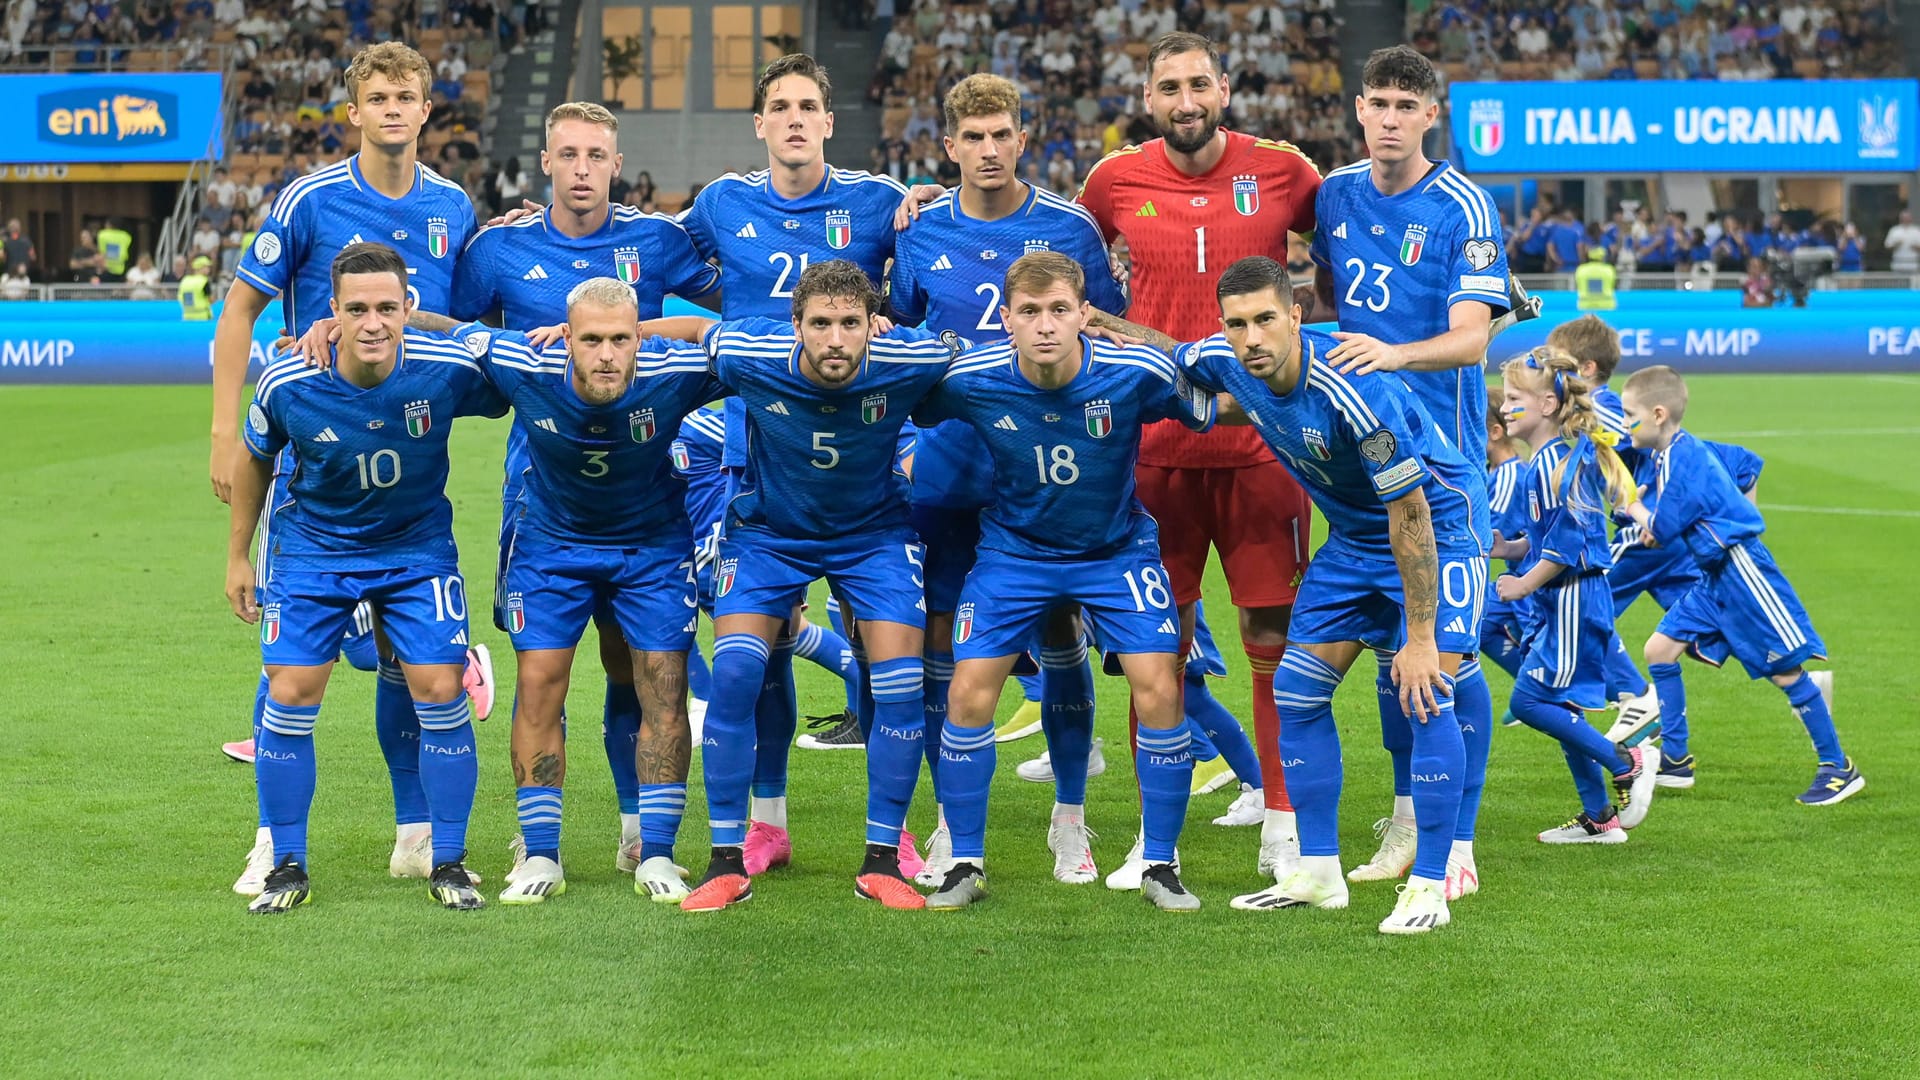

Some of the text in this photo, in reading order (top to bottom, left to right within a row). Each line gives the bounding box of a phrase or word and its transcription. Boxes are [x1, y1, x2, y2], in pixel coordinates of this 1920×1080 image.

[48, 99, 109, 136] eni
[1525, 107, 1841, 144] ITALIA - UCRAINA
[1235, 184, 1256, 192] ITALIA
[430, 225, 447, 234] ITALIA
[828, 218, 849, 226] ITALIA
[1406, 231, 1424, 241] ITALIA
[1195, 226, 1206, 272] 1
[616, 254, 637, 262] ITALIA
[1344, 257, 1394, 312] 23
[1685, 329, 1760, 356] МИР
[1, 339, 75, 367] МИР
[864, 399, 884, 407] ITALIA
[407, 408, 428, 418] ITALIA
[632, 415, 652, 425] ITALIA
[1088, 408, 1109, 416] ITALIA
[810, 432, 840, 469] 5
[356, 449, 402, 490] 10
[580, 451, 609, 478] 3
[1033, 444, 1080, 485] 18
[904, 544, 927, 589] 5
[679, 561, 698, 608] 3
[1123, 566, 1170, 612] 18
[430, 575, 466, 622] 10
[1052, 700, 1094, 712] ITALIA
[881, 725, 924, 741] ITALIA
[258, 747, 297, 760] ITALIA
[425, 744, 471, 755] ITALIA
[940, 748, 973, 762] TALIA
[1150, 752, 1192, 765] ITALIA
